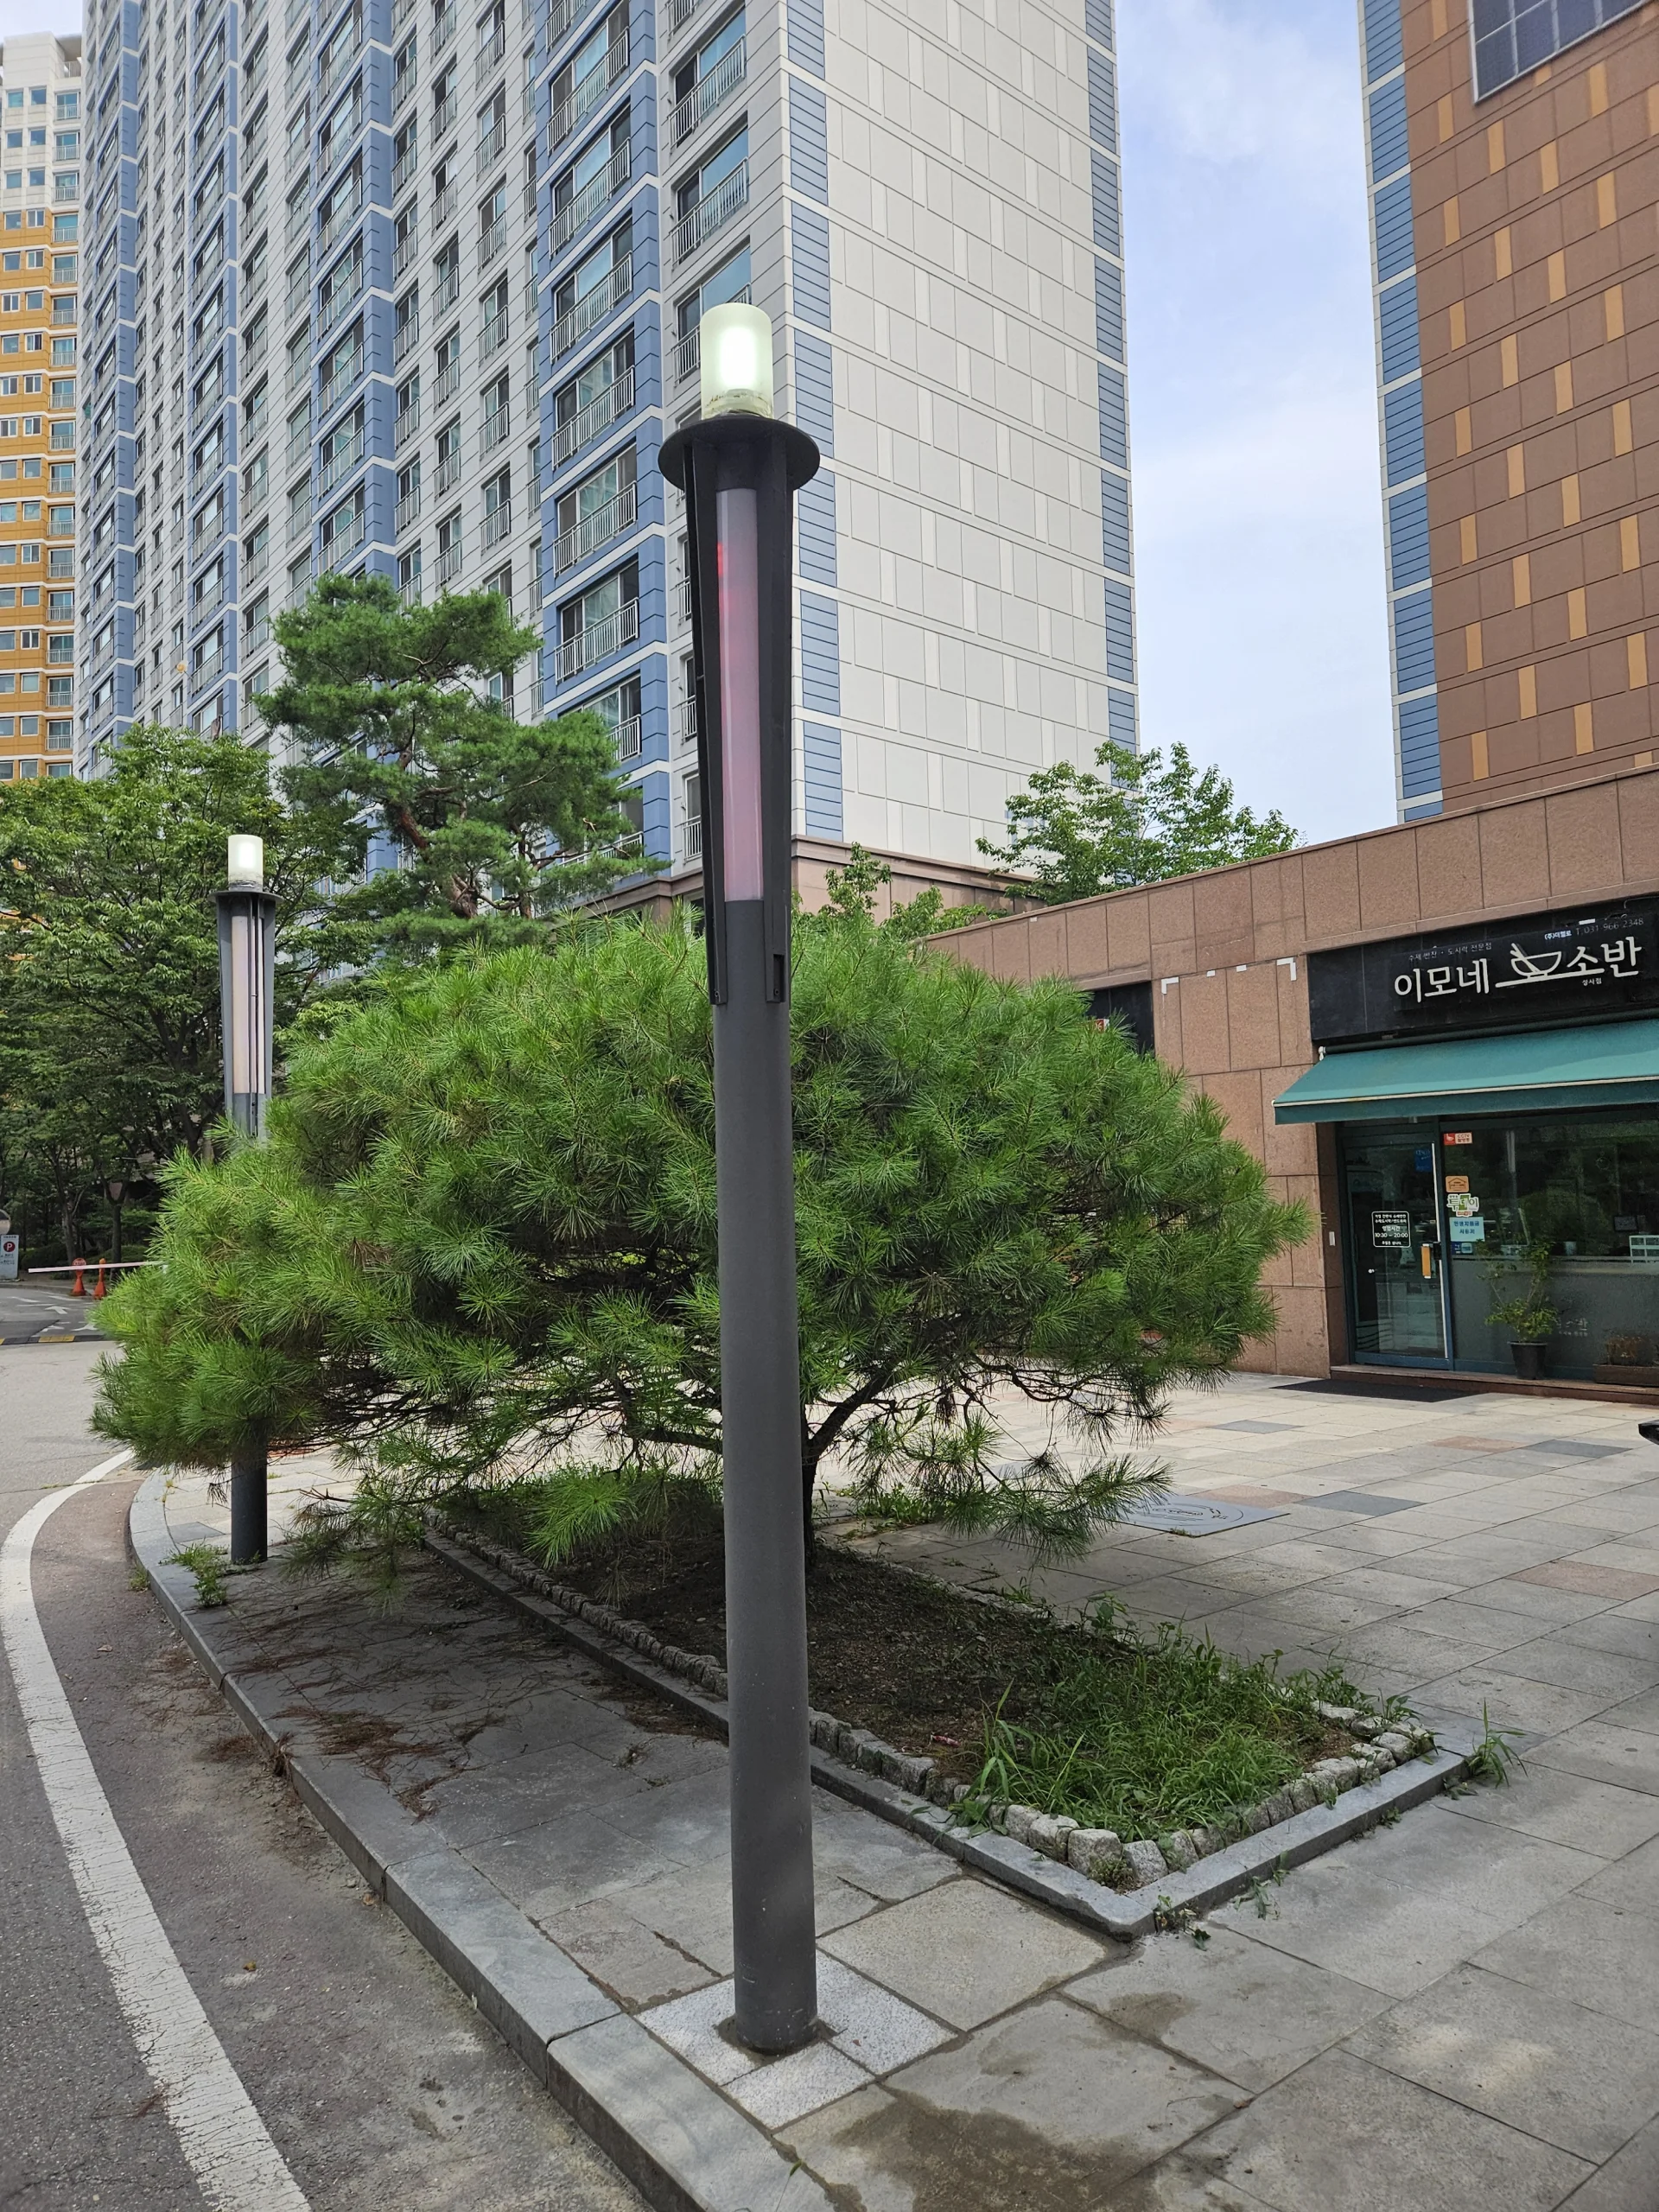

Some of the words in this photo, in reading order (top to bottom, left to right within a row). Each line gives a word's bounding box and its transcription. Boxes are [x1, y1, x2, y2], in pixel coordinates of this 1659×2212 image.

[1603, 922, 1619, 931] 966
[1623, 918, 1643, 928] 2348
[1394, 957, 1490, 1003] 이모네
[1566, 936, 1642, 978] 소반
[1581, 977, 1602, 986] 성사점
